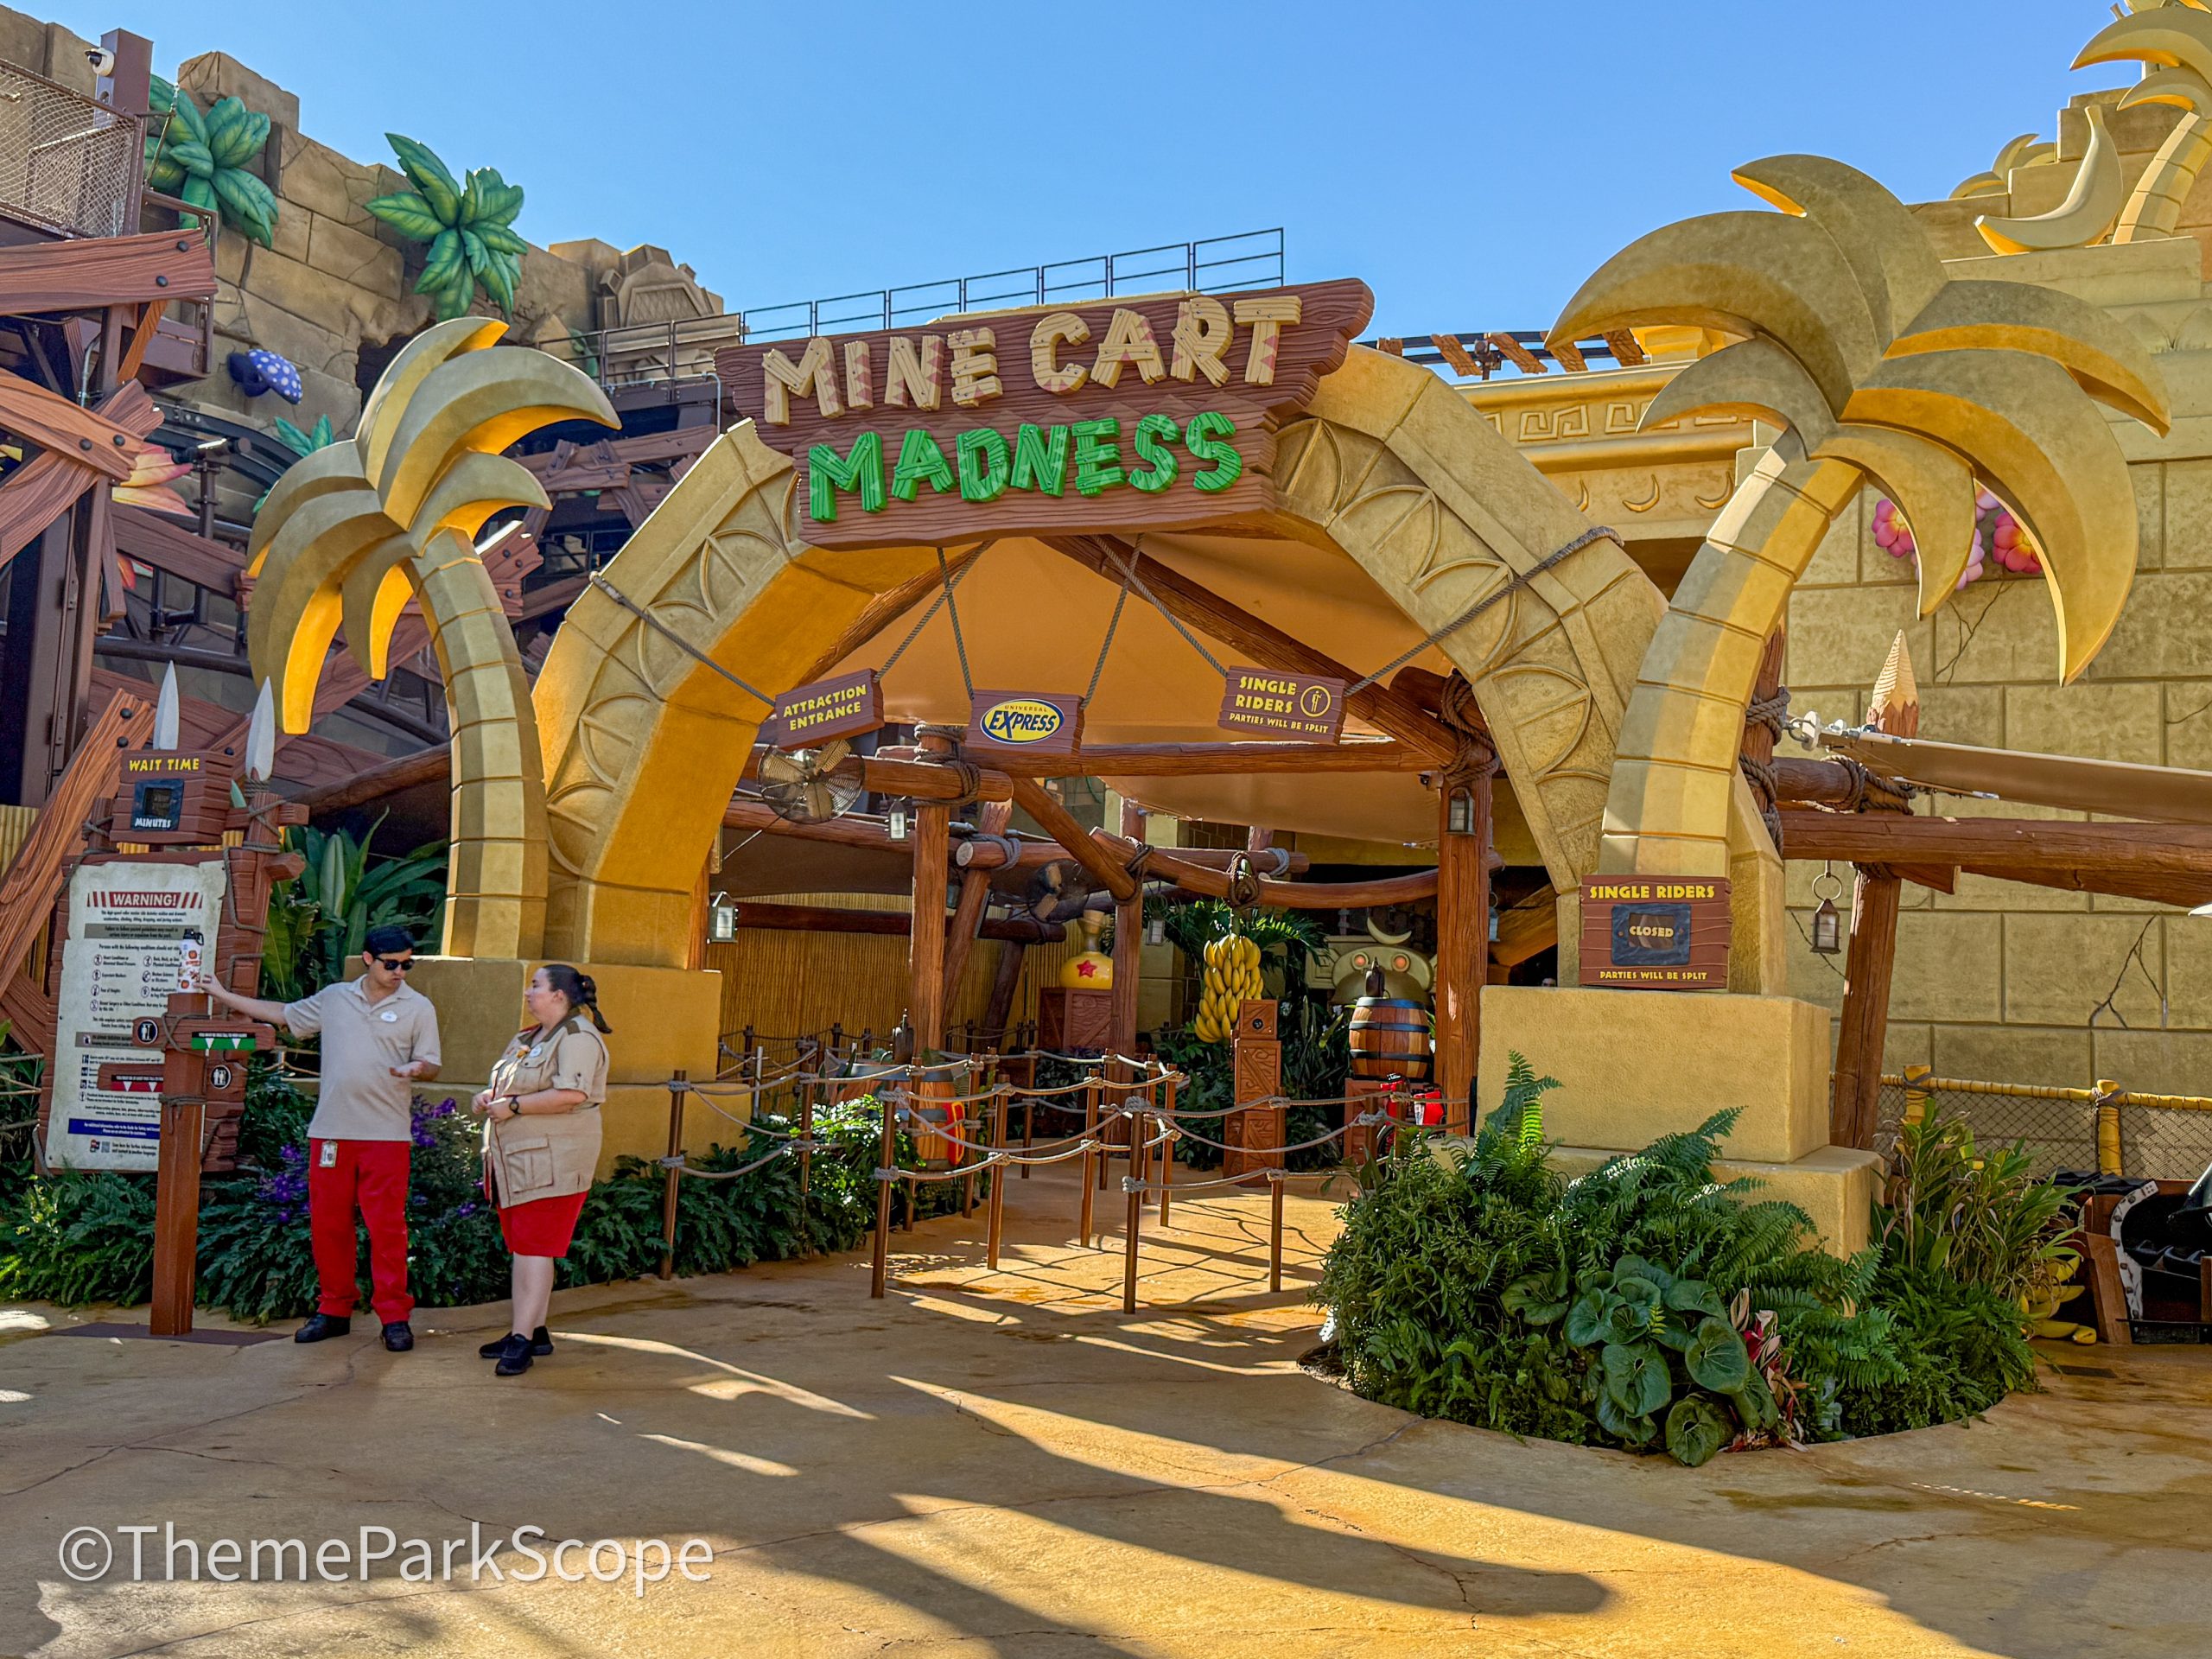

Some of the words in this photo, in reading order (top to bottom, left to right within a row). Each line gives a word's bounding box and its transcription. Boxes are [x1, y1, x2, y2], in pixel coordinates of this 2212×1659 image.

[762, 327, 1003, 426] MINE
[1030, 296, 1302, 395] CART
[808, 411, 1243, 522] MADNESS
[1239, 676, 1297, 696] SINGLE
[783, 684, 867, 718] ATTRACTION
[1004, 704, 1047, 713] UNIVERSAL
[1235, 694, 1294, 714] RIDERS
[789, 702, 861, 731] ENTRANCE
[988, 710, 1057, 739] EXPRESS
[1229, 712, 1264, 725] PARTIES
[1267, 718, 1288, 728] WILL
[1290, 721, 1302, 730] BE
[1305, 723, 1329, 734] SPLIT
[129, 760, 162, 772] WAIT
[168, 758, 200, 771] TIME
[135, 817, 171, 829] MINUTES
[113, 893, 176, 906] WARNING!
[1590, 886, 1650, 899] SINGLE
[1656, 885, 1715, 899] RIDERS
[1629, 925, 1675, 938] CLOSED
[1640, 971, 1663, 980] WILL
